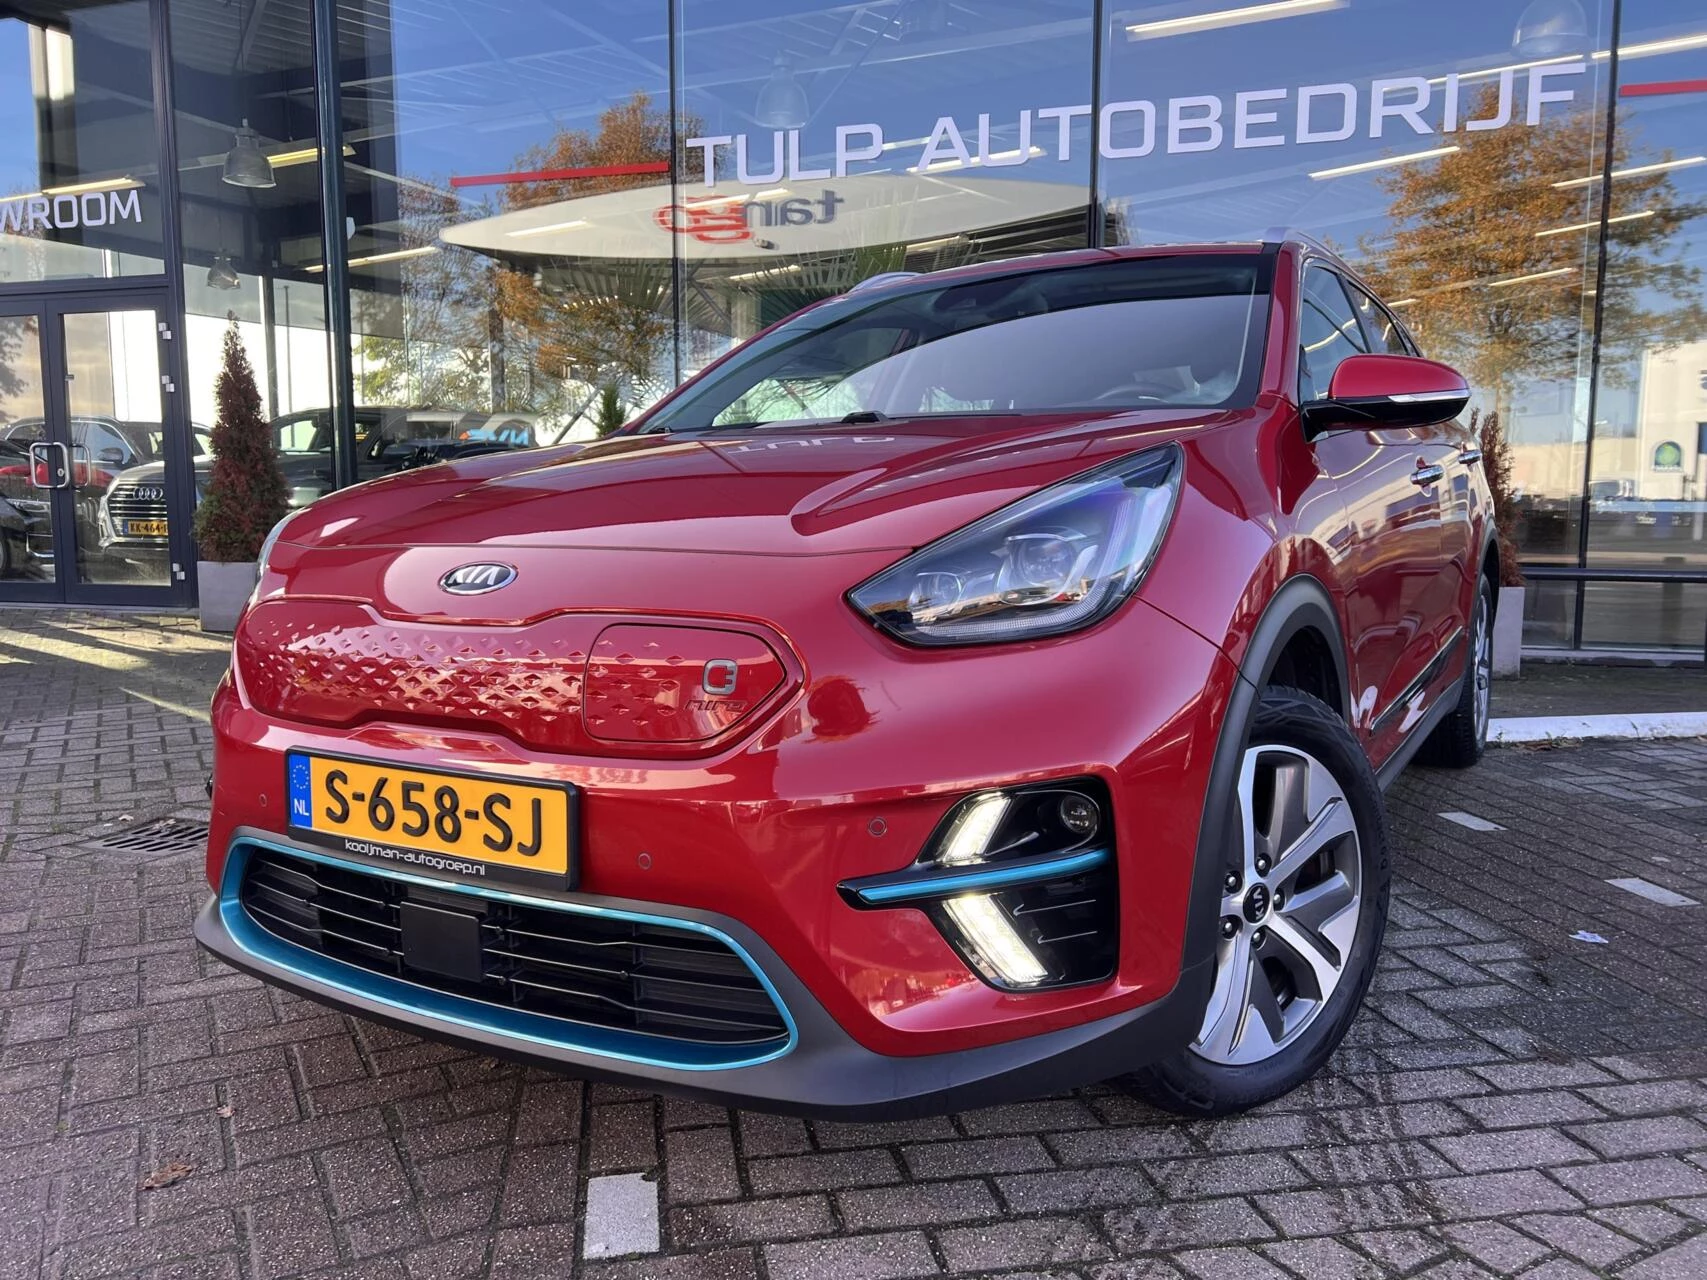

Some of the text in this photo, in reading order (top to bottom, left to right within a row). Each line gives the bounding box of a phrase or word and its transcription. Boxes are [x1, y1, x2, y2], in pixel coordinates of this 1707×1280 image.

[686, 62, 1587, 187] TULP AUTOBEDRIJF
[293, 797, 310, 817] NL
[325, 768, 542, 857] S-658-SJ
[344, 838, 486, 876] kooijman-autogroep.nl
[1251, 887, 1264, 921] KIA
